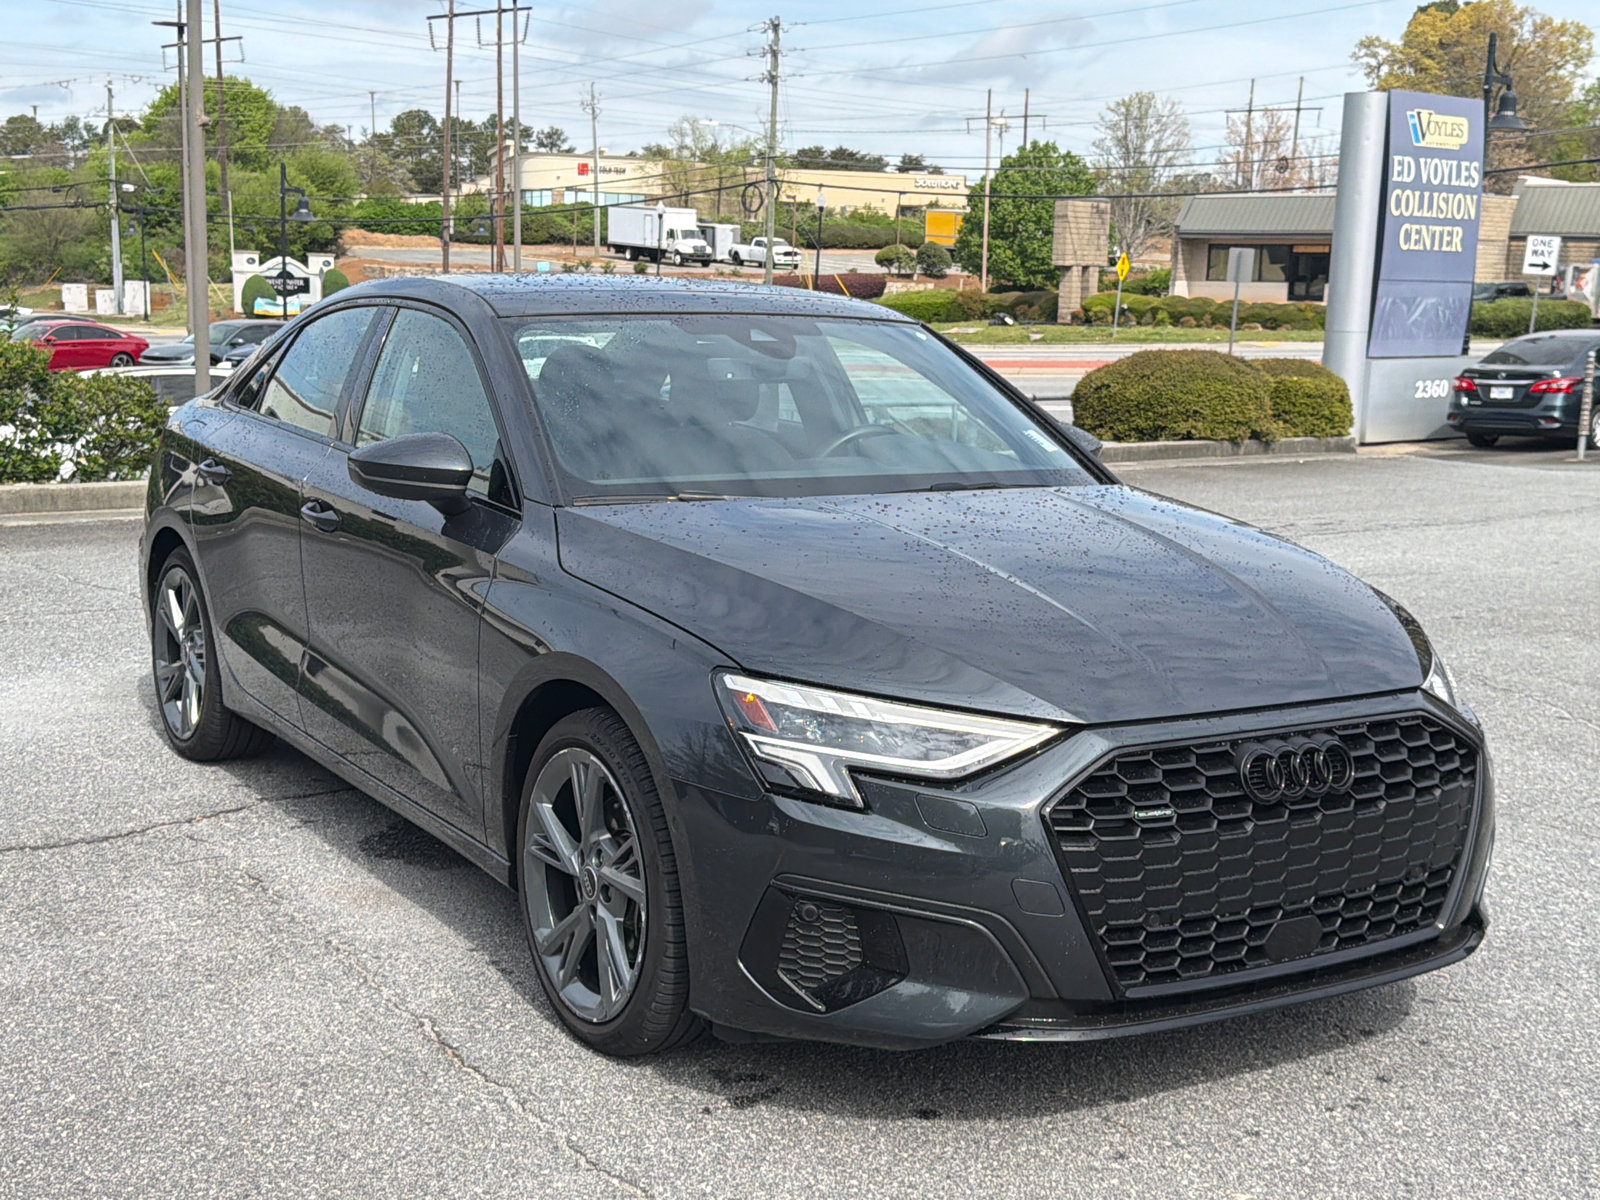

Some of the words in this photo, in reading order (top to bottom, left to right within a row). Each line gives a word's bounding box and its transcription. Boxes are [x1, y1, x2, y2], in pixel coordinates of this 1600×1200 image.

[1391, 155, 1416, 183] ED
[1418, 158, 1480, 188] VOYLES
[1390, 189, 1478, 220] COLLISION
[1399, 223, 1463, 252] CENTER
[1532, 238, 1554, 248] ONE
[1531, 249, 1554, 259] WAY
[1414, 379, 1449, 399] 2360
